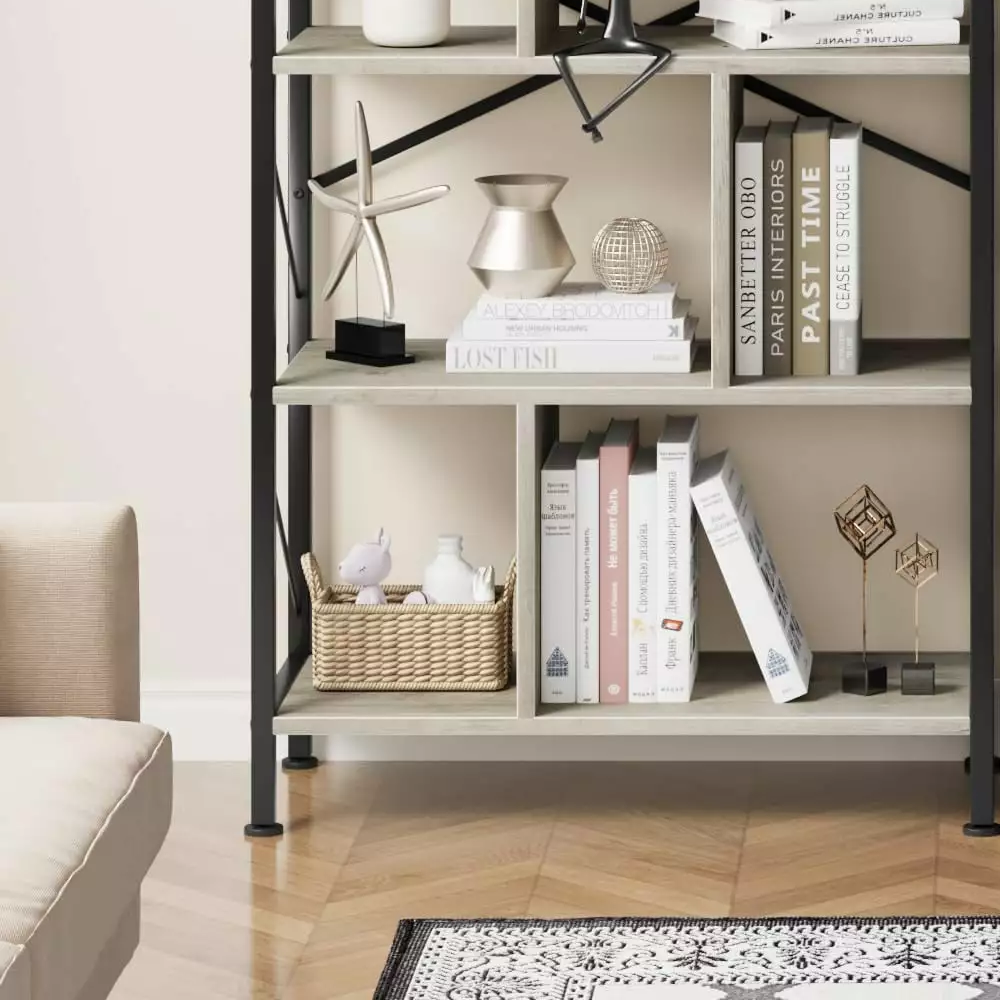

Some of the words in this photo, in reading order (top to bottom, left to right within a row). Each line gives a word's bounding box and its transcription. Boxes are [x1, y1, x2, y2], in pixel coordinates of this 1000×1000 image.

[740, 177, 756, 219] OBO
[770, 158, 784, 280] INTERIORS
[801, 167, 820, 248] TIME
[836, 164, 850, 238] STRUGGLE
[836, 243, 850, 260] TO
[483, 302, 546, 318] ALEXEY
[740, 226, 756, 345] SANBETTER
[801, 261, 820, 343] PAST
[836, 264, 850, 310] CEASE
[770, 289, 784, 356] PARIS
[454, 347, 507, 369] LOST
